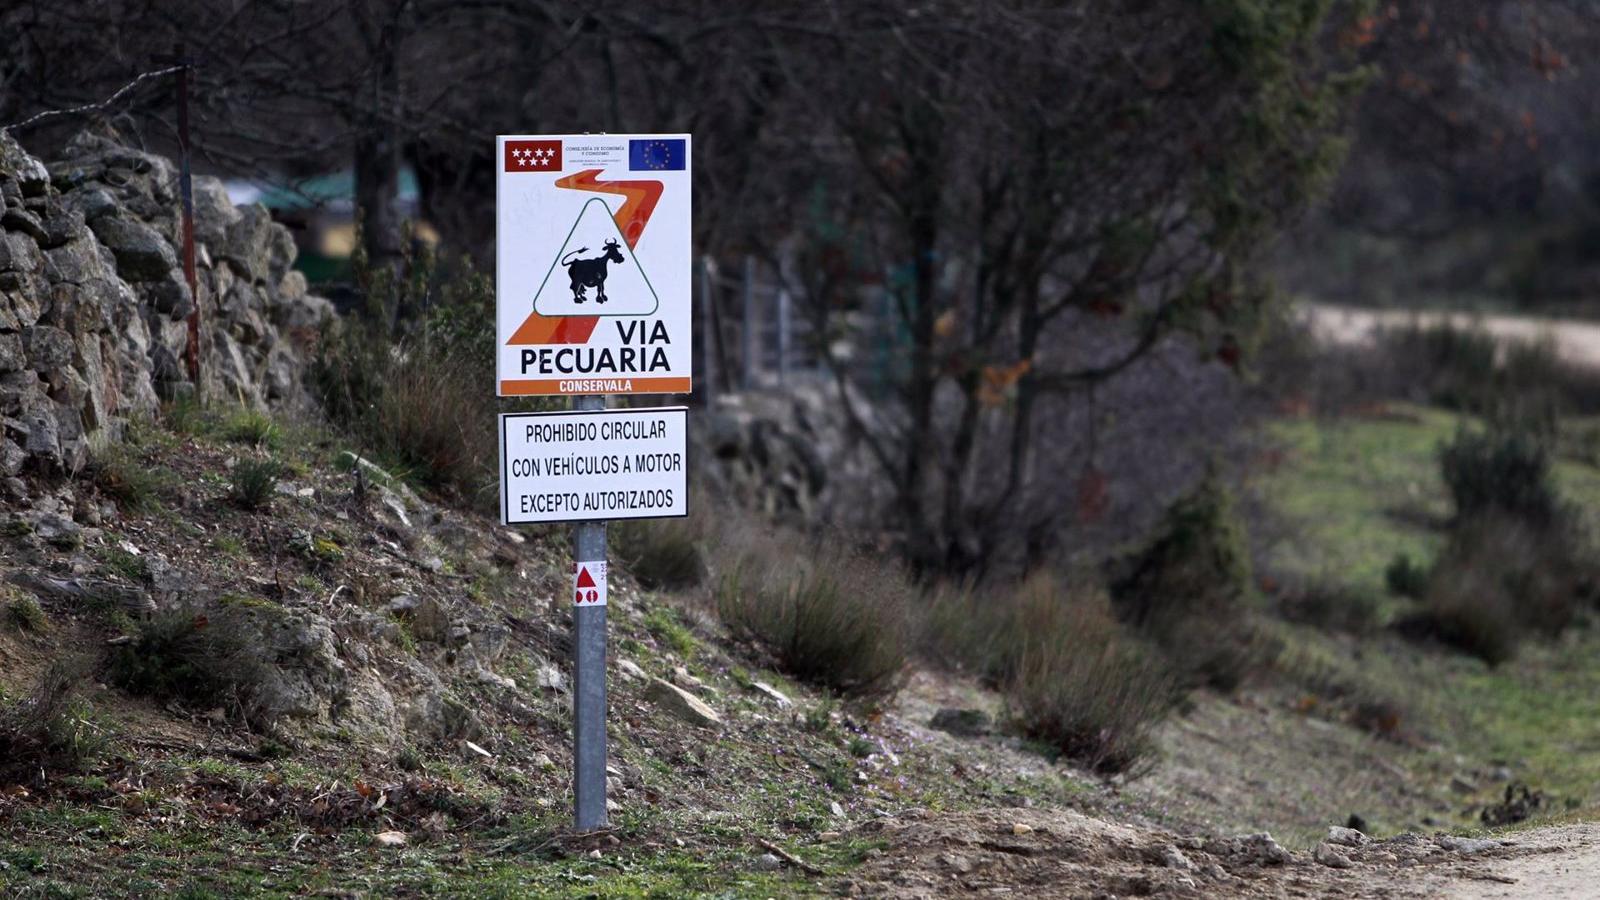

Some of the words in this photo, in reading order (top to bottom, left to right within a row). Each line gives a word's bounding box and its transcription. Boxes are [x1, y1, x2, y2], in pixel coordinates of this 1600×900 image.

[616, 320, 671, 345] VIA
[521, 347, 671, 374] PECUARIA
[559, 379, 632, 392] CONSERVALA
[526, 422, 597, 443] PROHIBIDO
[601, 420, 666, 440] CIRCULAR
[512, 458, 540, 477] CON
[545, 452, 619, 476] VEHÍCULOS
[623, 455, 631, 474] A
[635, 453, 681, 473] MOTOR
[520, 493, 580, 513] EXCEPTO
[583, 489, 673, 511] AUTORIZADOS
